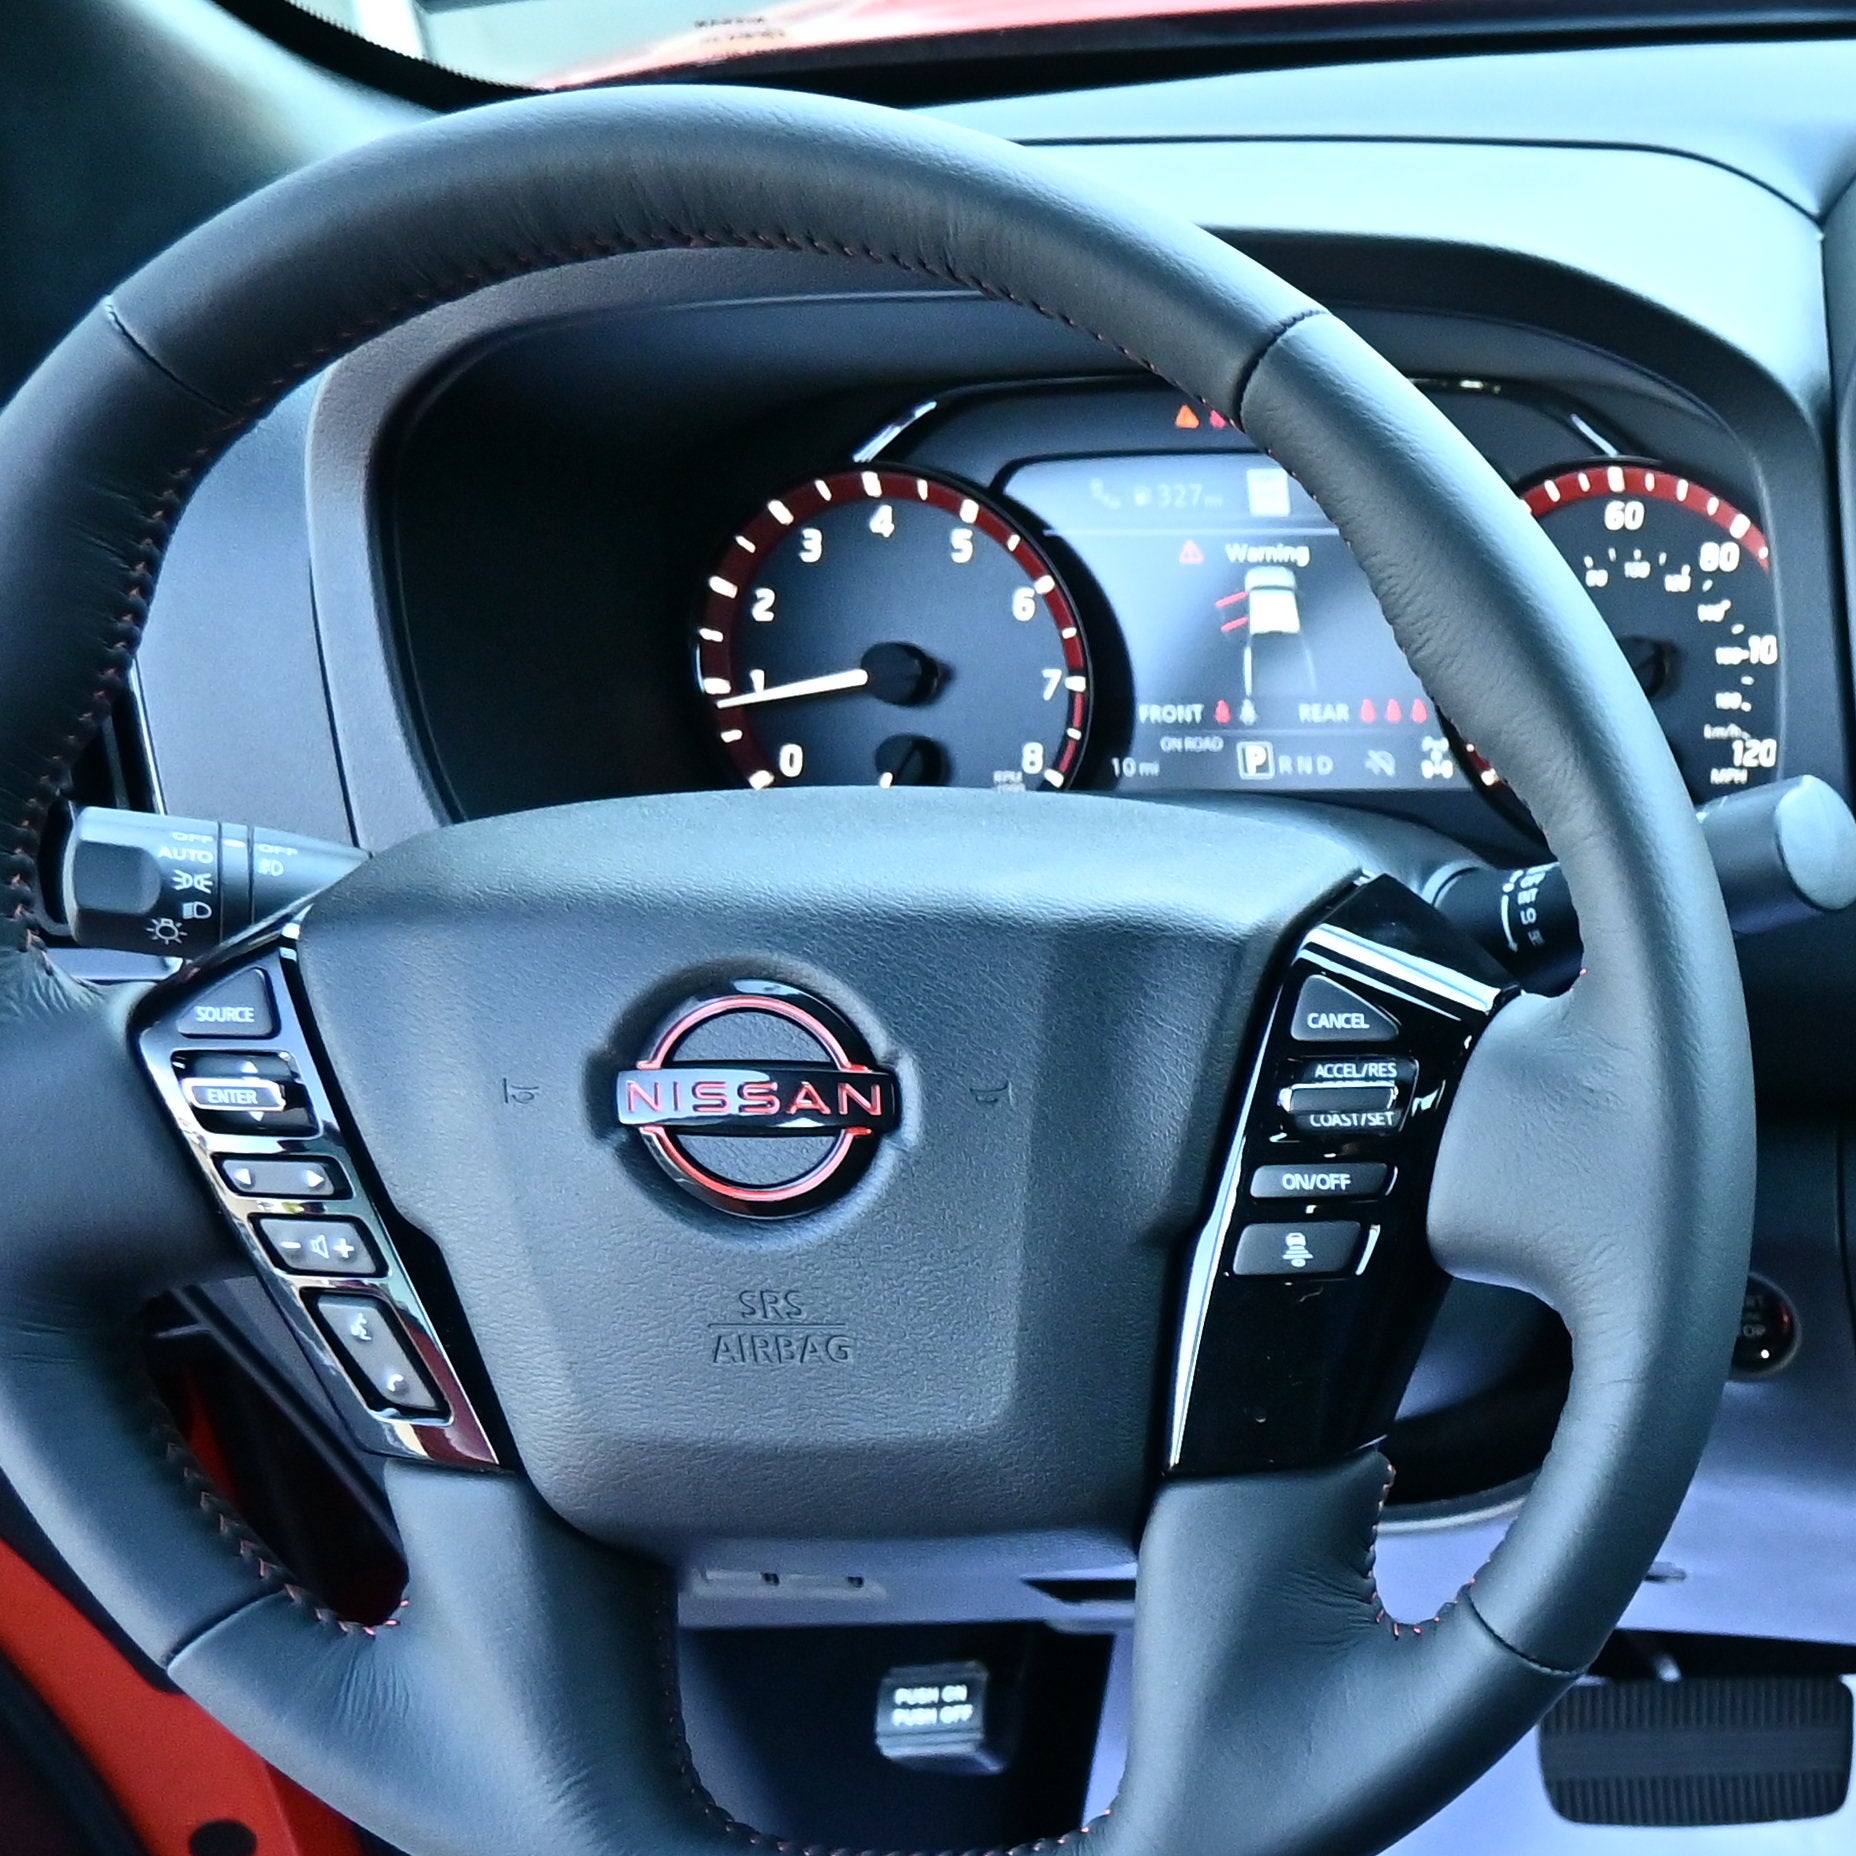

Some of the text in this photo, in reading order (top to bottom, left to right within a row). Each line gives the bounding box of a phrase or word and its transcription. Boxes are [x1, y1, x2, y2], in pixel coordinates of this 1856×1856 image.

[869, 505, 895, 538] 4
[1604, 500, 1645, 531] 60
[800, 529, 823, 563] 3
[950, 529, 974, 563] 5
[1225, 542, 1312, 568] Warning
[1699, 541, 1740, 572] 80
[752, 589, 775, 622] 2
[1012, 588, 1036, 622] 6
[1041, 669, 1062, 702] 7
[1139, 703, 1204, 723] FRONT
[1299, 703, 1350, 723] REAR
[780, 744, 803, 777] 0
[1022, 742, 1044, 774] 8
[1112, 758, 1136, 777] 10
[1249, 745, 1334, 776] P R N D
[1732, 739, 1777, 768] 120
[158, 846, 214, 864] AUTO
[195, 1006, 255, 1024] SOURCE
[1307, 1011, 1370, 1030] CANCEL
[1315, 1062, 1398, 1079] ACCEL/RES
[206, 1086, 258, 1105] ENTER
[626, 1079, 883, 1116] NISSAN
[1310, 1111, 1395, 1128] COAST/SET
[1282, 1172, 1352, 1191] ON/OFF
[738, 1289, 805, 1319] SRS
[712, 1333, 855, 1365] AIRBAG
[894, 1684, 968, 1706] PUSH ON
[892, 1704, 974, 1727] PUSH OFF
